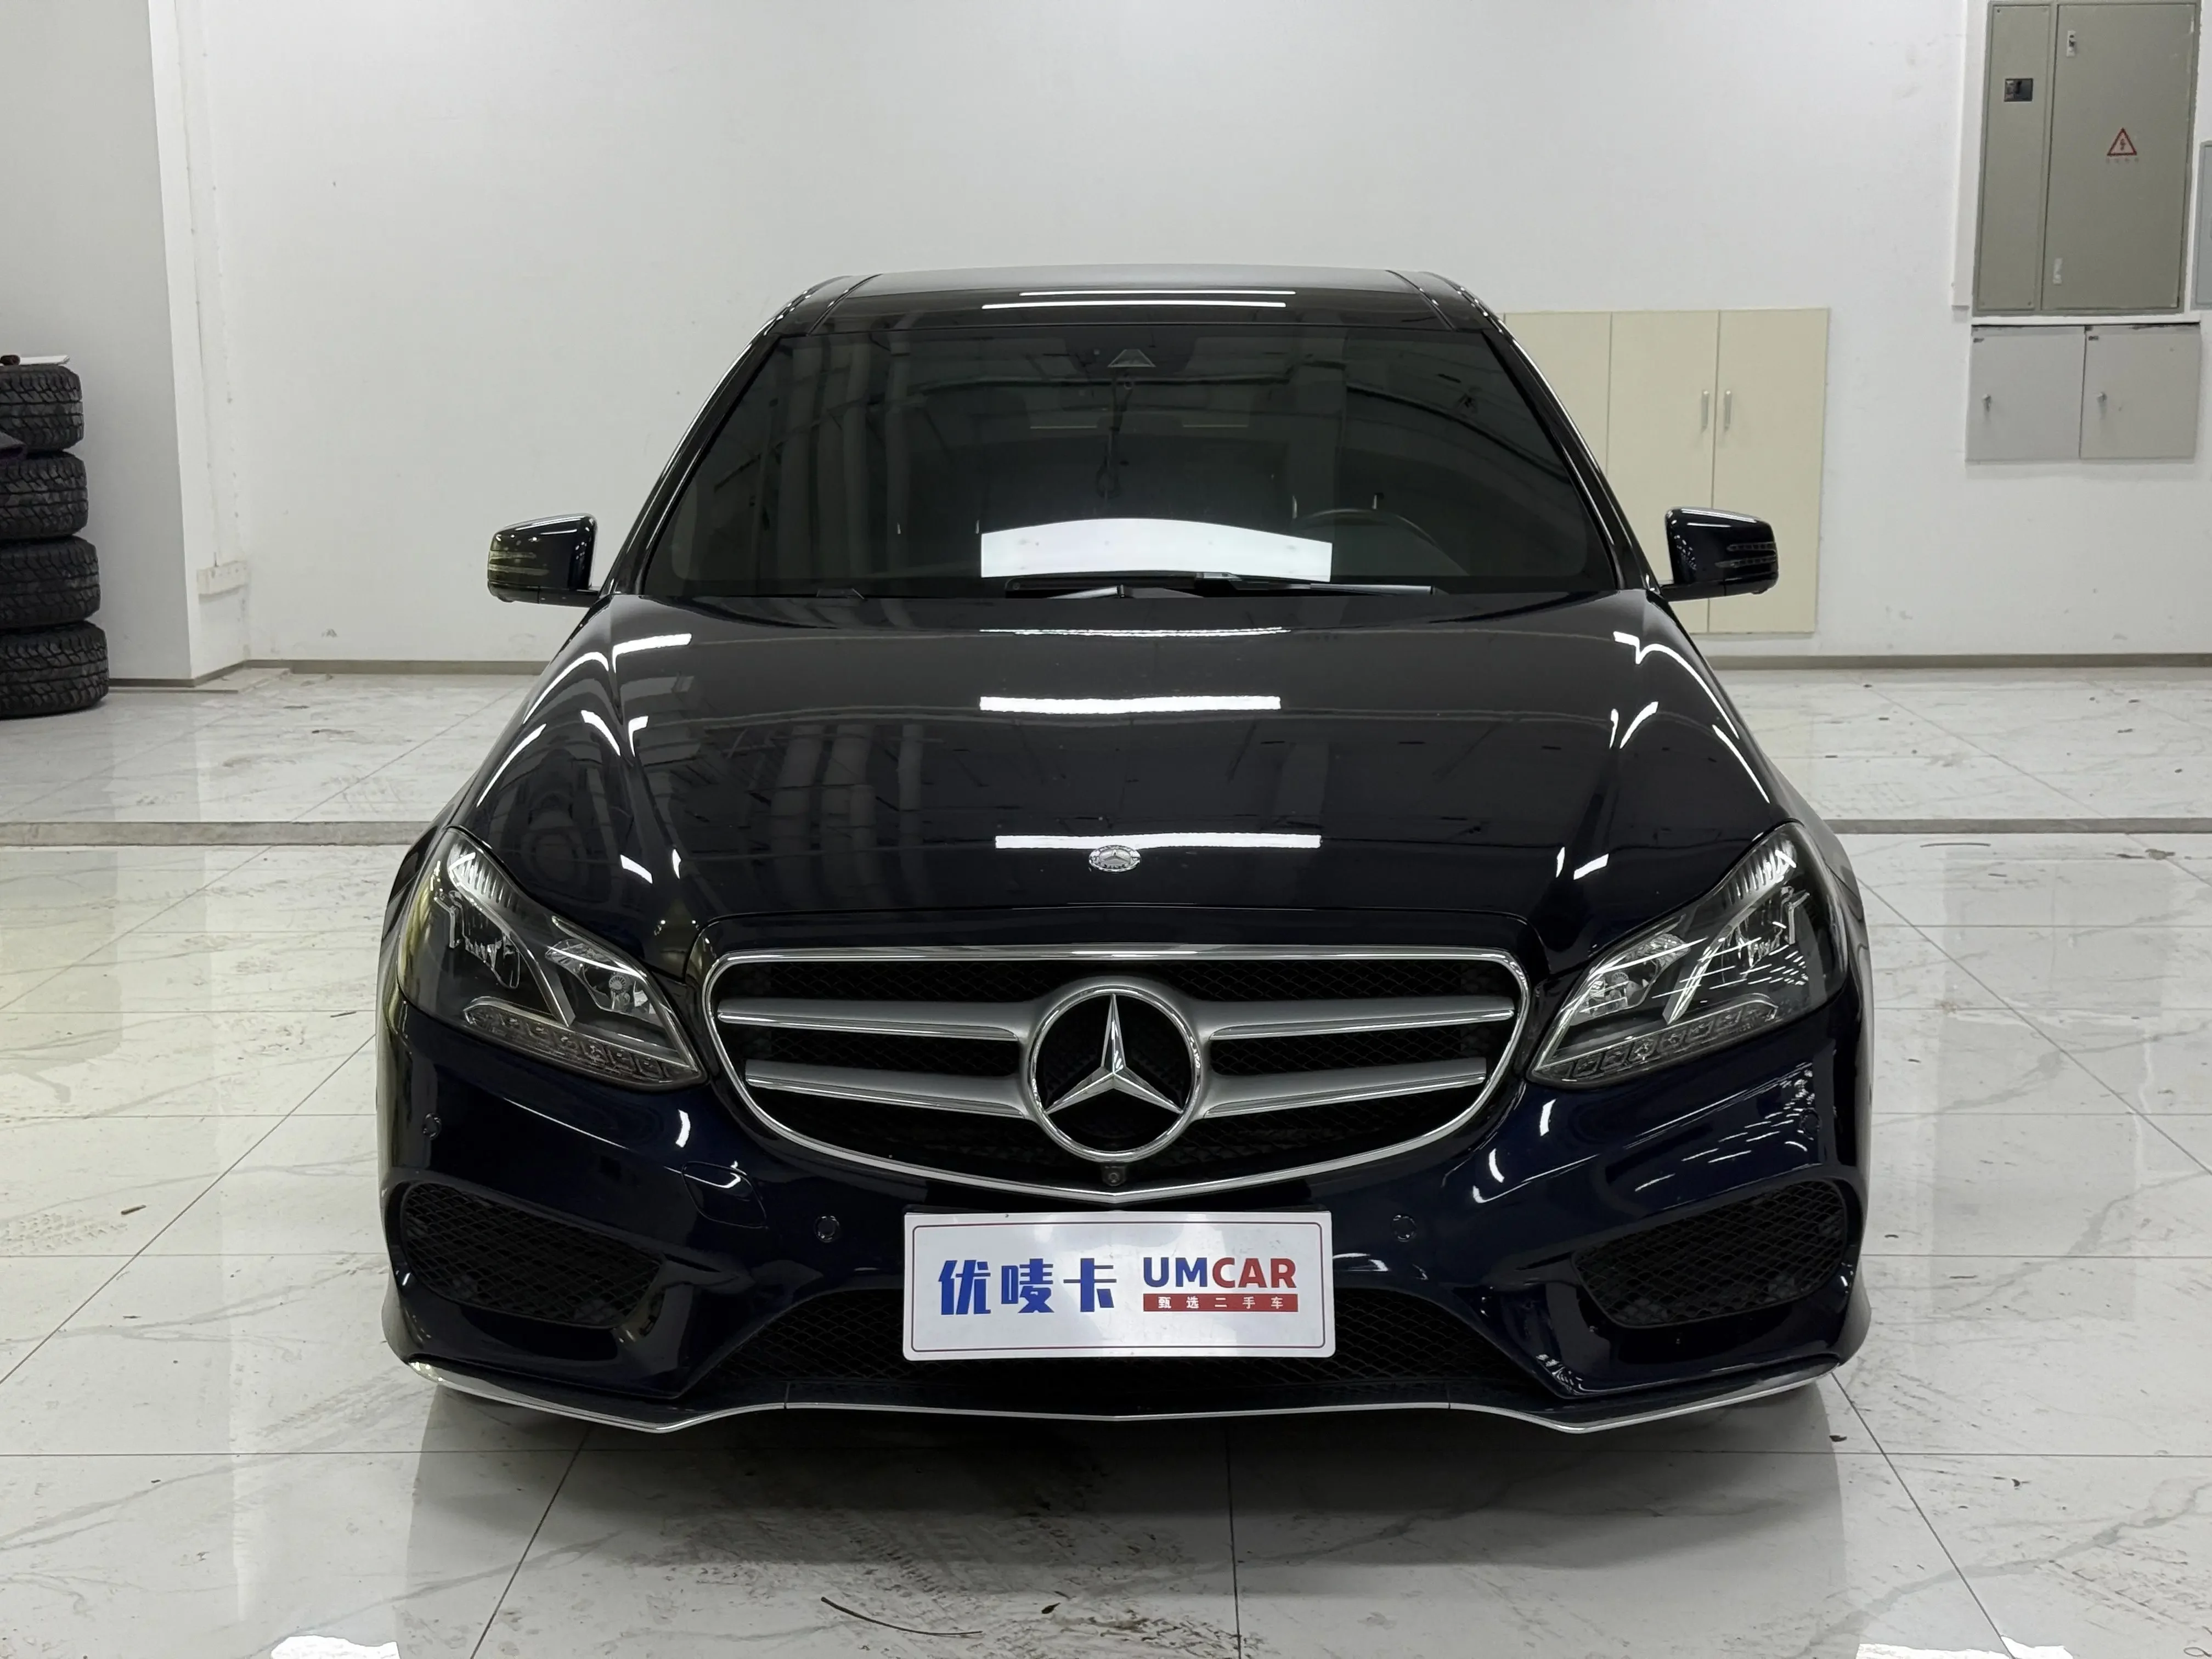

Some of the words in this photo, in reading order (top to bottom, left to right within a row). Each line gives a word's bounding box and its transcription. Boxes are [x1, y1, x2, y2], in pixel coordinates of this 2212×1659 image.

[938, 1258, 1116, 1316] 优唛卡
[1143, 1257, 1296, 1288] UMCAR
[1158, 1296, 1284, 1310] 甄选二手车
